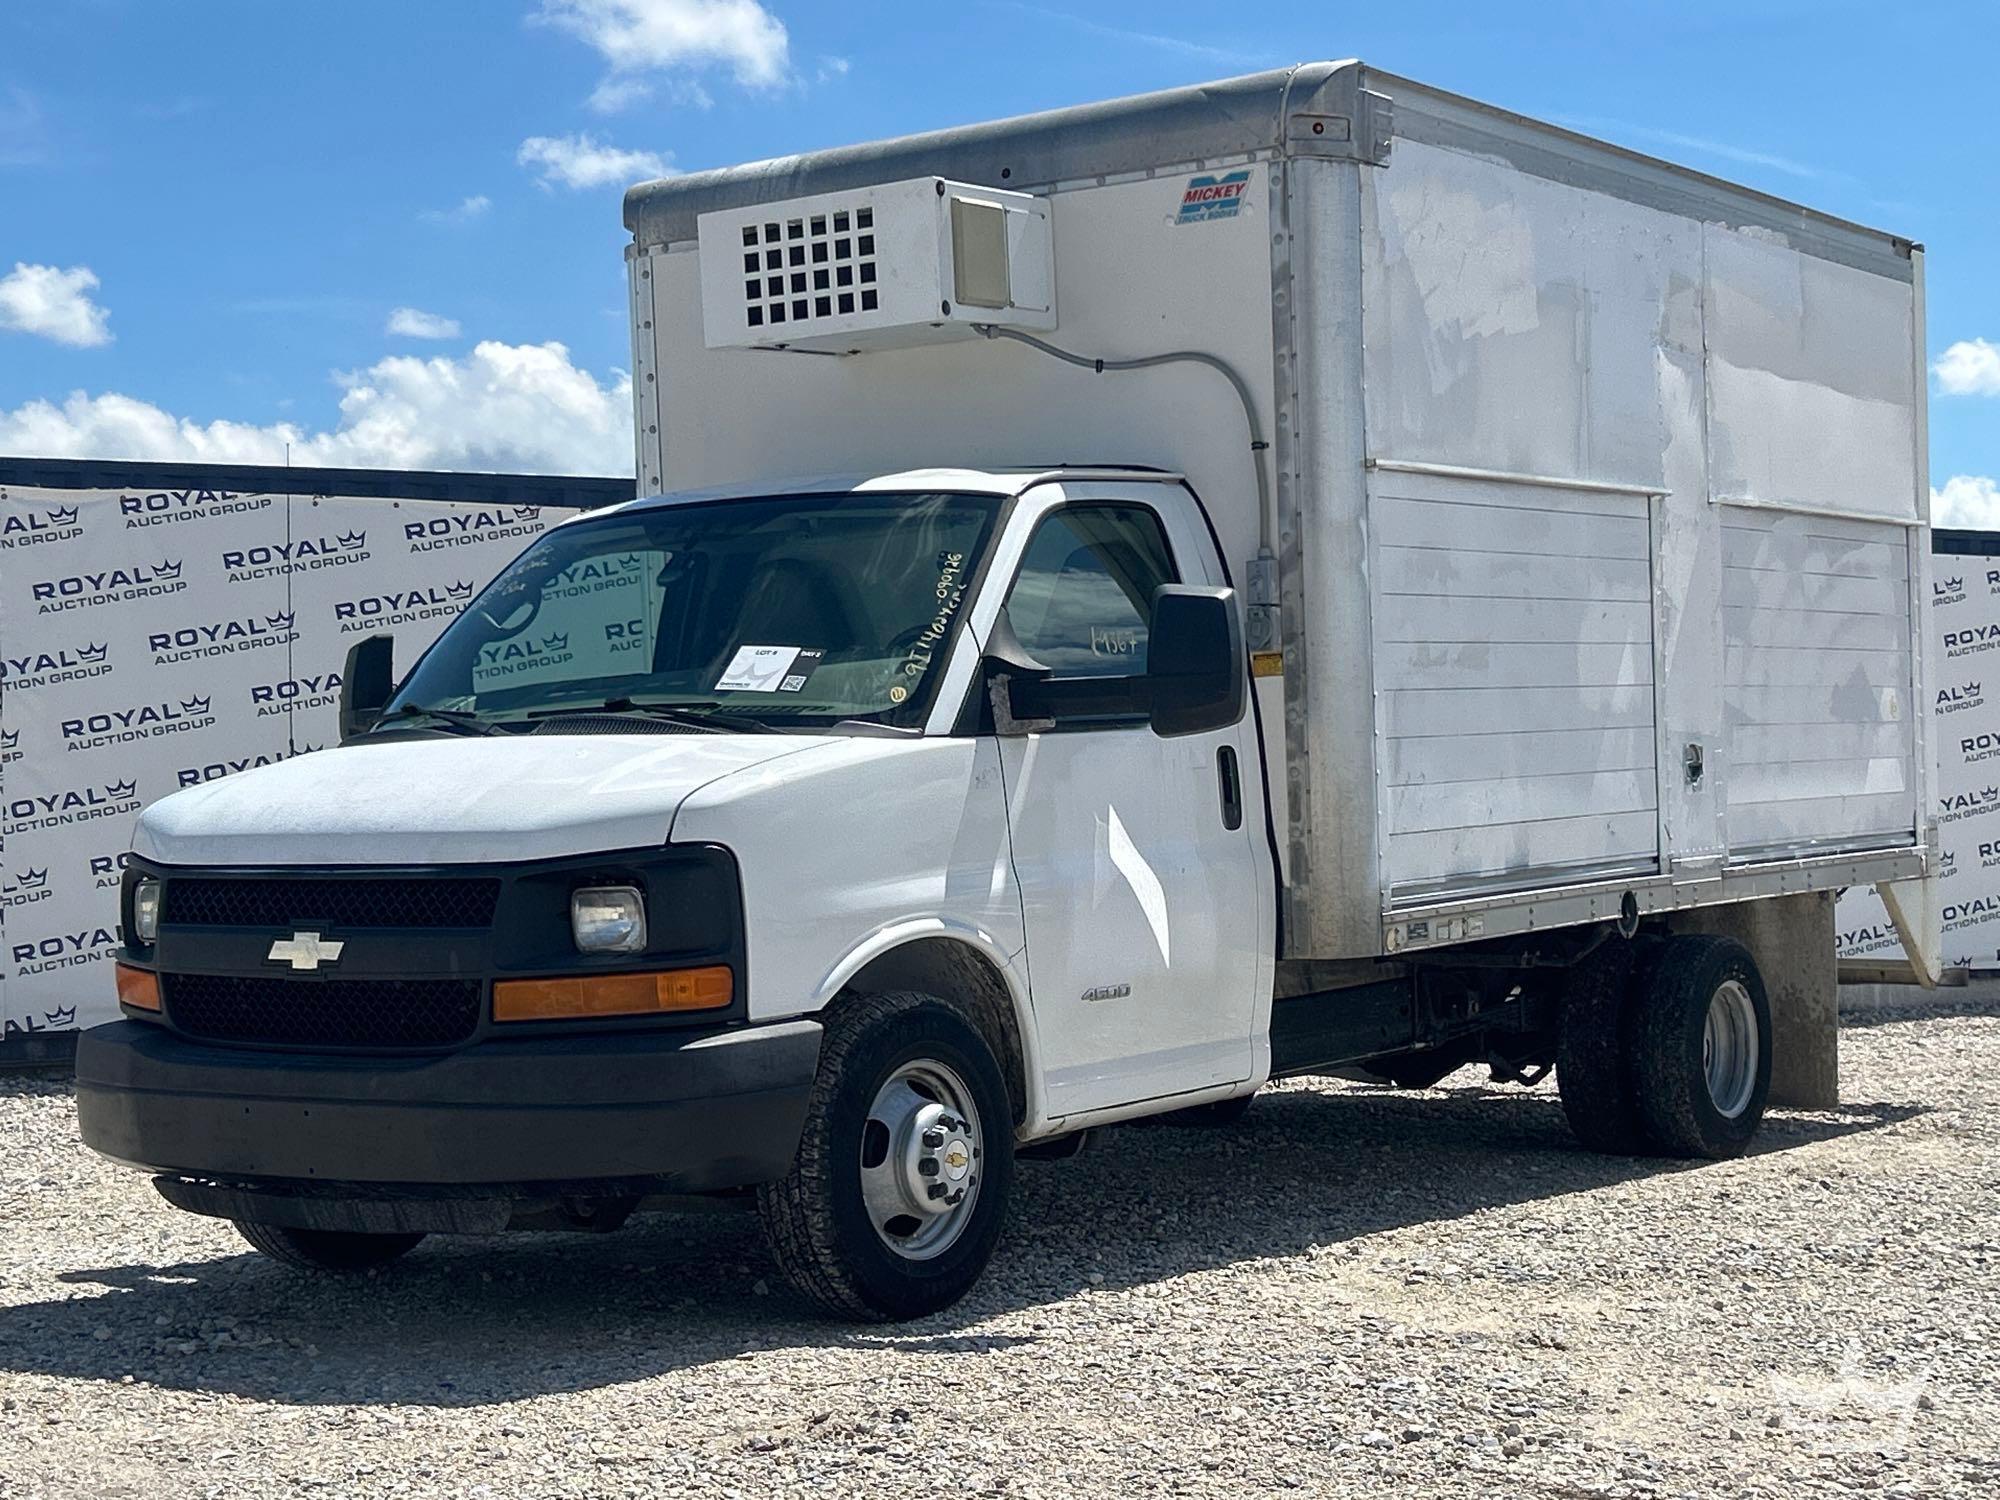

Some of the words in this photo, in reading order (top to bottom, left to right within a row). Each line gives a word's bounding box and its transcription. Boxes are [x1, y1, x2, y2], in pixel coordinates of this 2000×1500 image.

[1184, 182, 1246, 204] MICKEY
[120, 490, 238, 515] ROYAL
[126, 508, 206, 529] AUCTION
[210, 499, 272, 517] GROUP
[18, 528, 84, 546] GROUP
[404, 509, 515, 541] ROYAL
[409, 532, 485, 553] AUCTION
[488, 522, 546, 542] GROUP
[222, 536, 339, 570] ROYAL
[228, 562, 307, 583] AUCTION
[310, 551, 371, 569] GROUP
[32, 567, 152, 601] ROYAL
[38, 592, 120, 615] AUCTION
[124, 581, 187, 602] GROUP
[334, 587, 447, 620] ROYAL
[148, 619, 267, 652] ROYAL
[340, 611, 417, 634] AUCTION
[154, 643, 235, 665] AUCTION
[238, 632, 300, 651] GROUP
[474, 640, 543, 667] YAL
[517, 652, 574, 671] GROUP
[1947, 641, 1996, 659] AUCTION
[49, 664, 113, 684] GROUP
[257, 694, 336, 717] AUCTION
[1945, 698, 1984, 713] GROUP
[61, 703, 182, 738] ROYAL
[67, 727, 149, 752] AUCTION
[152, 716, 216, 736] GROUP
[3, 788, 107, 820] OYAL
[76, 800, 142, 822] GROUP
[0, 889, 53, 908] ROUP
[18, 951, 102, 977] AUCTION
